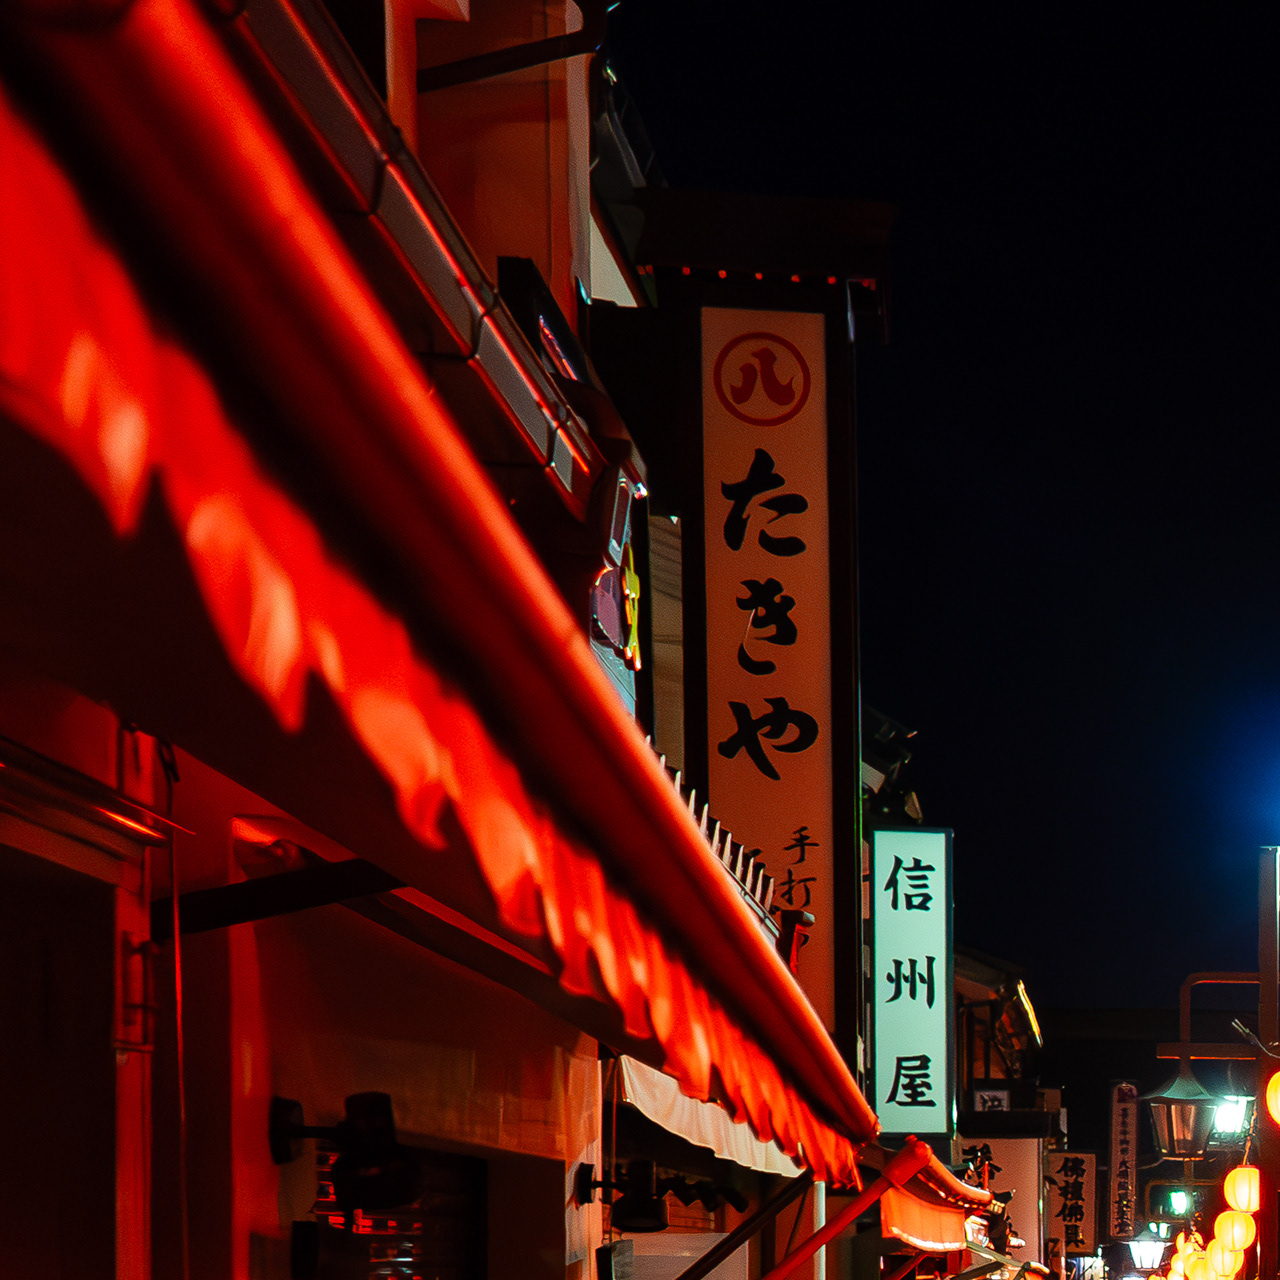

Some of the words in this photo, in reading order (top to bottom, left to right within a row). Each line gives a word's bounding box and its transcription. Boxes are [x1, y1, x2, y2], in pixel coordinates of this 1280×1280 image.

[716, 448, 819, 782] たきや
[883, 856, 938, 1109] 信州屋
